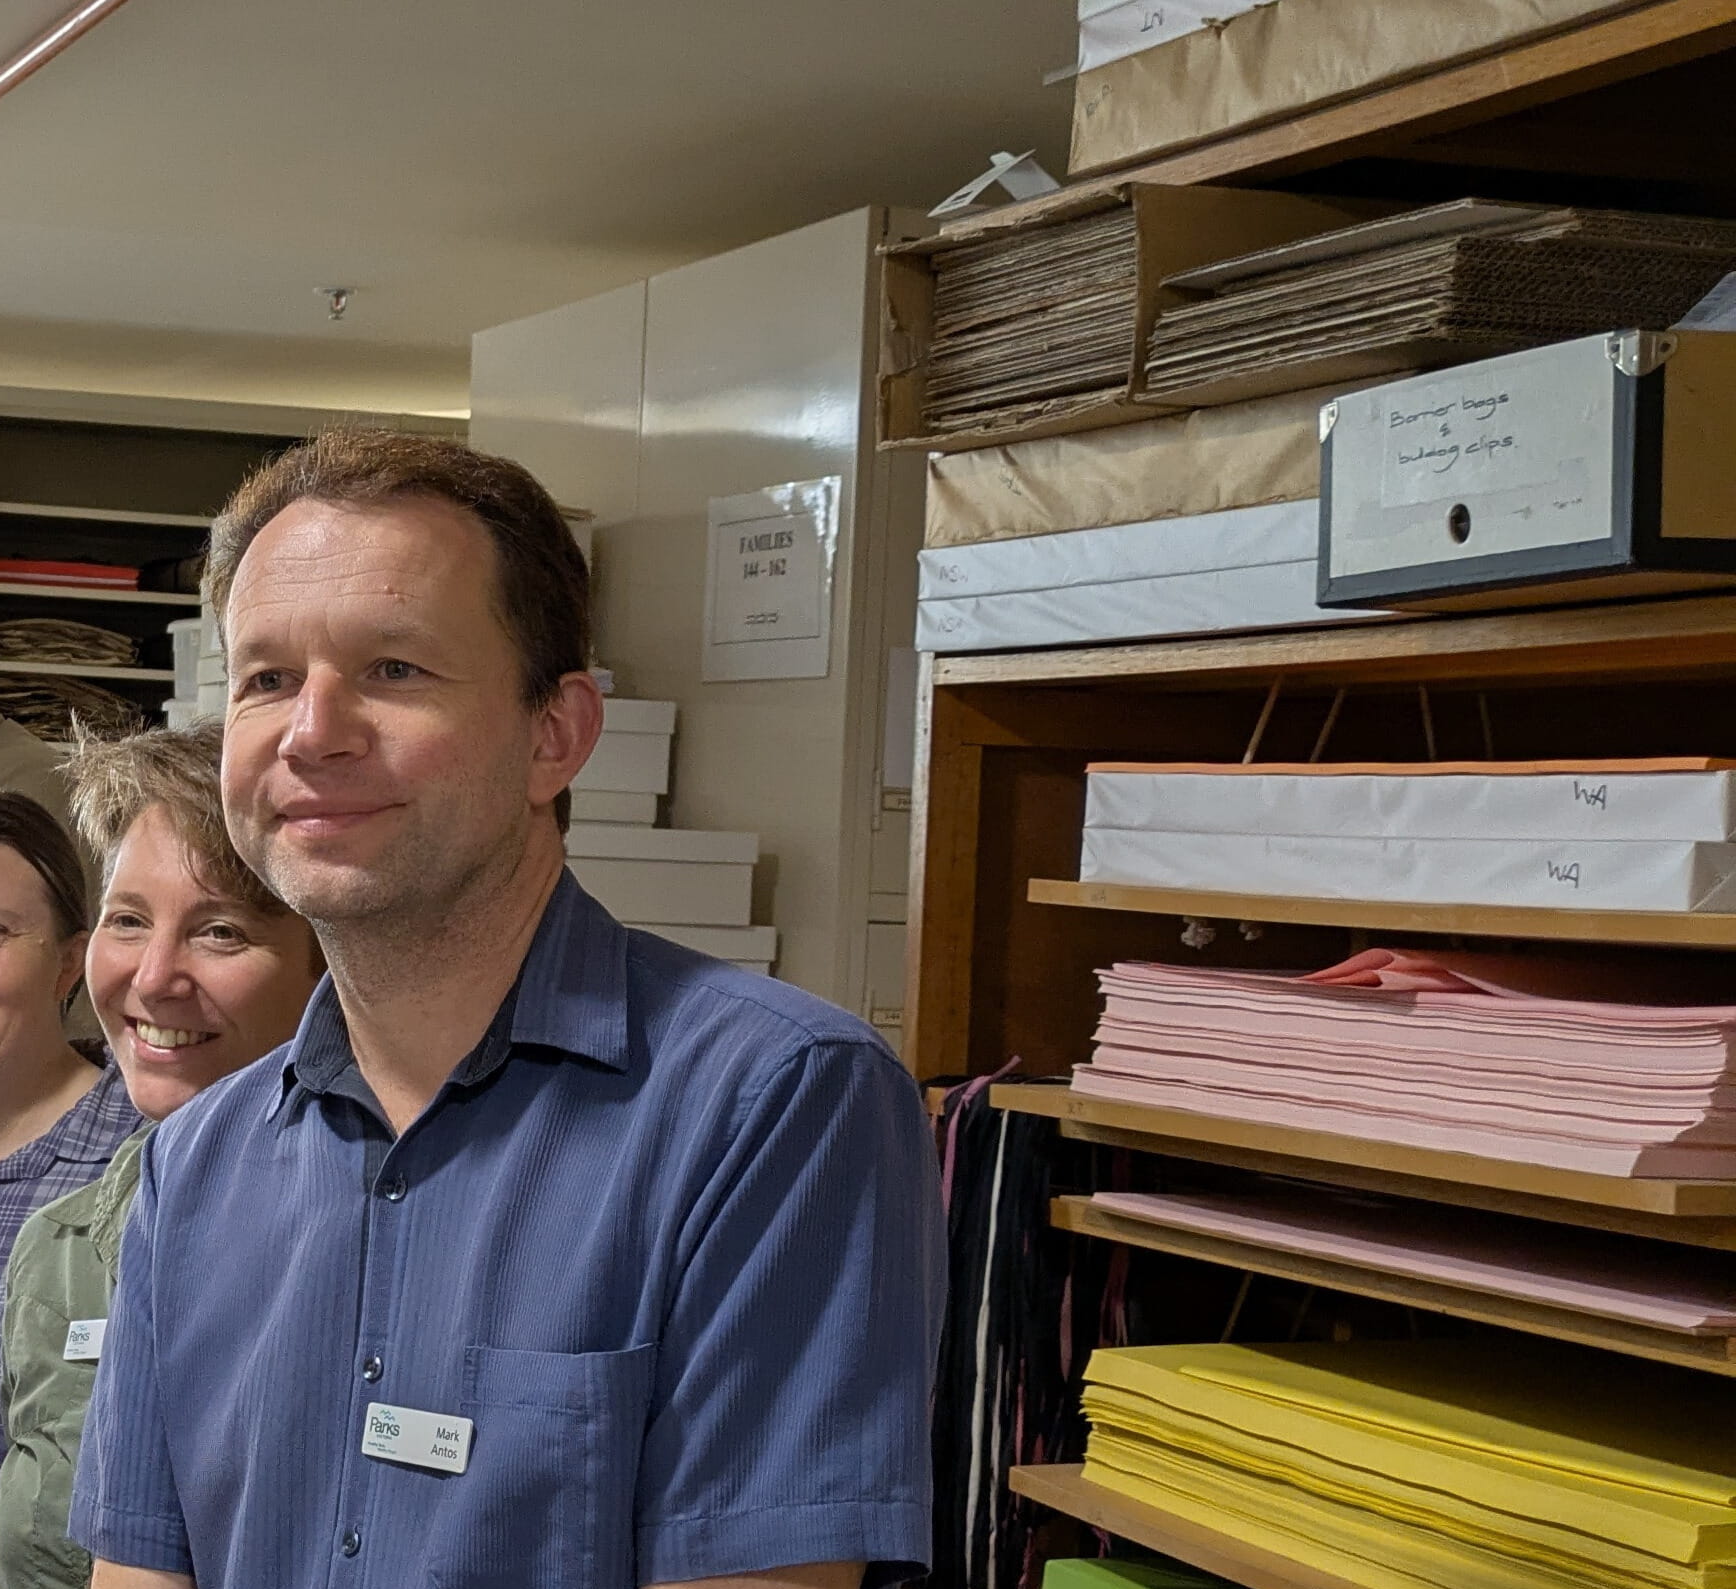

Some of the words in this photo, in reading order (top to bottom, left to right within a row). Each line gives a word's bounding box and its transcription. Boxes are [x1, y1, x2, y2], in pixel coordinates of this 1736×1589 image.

[739, 531, 793, 554] FAMILIES
[1574, 780, 1607, 811] WA
[1547, 860, 1580, 889] WA
[70, 1331, 90, 1341] Parks
[369, 1416, 400, 1437] Parks
[436, 1427, 460, 1443] Mark
[430, 1443, 458, 1460] Antos
